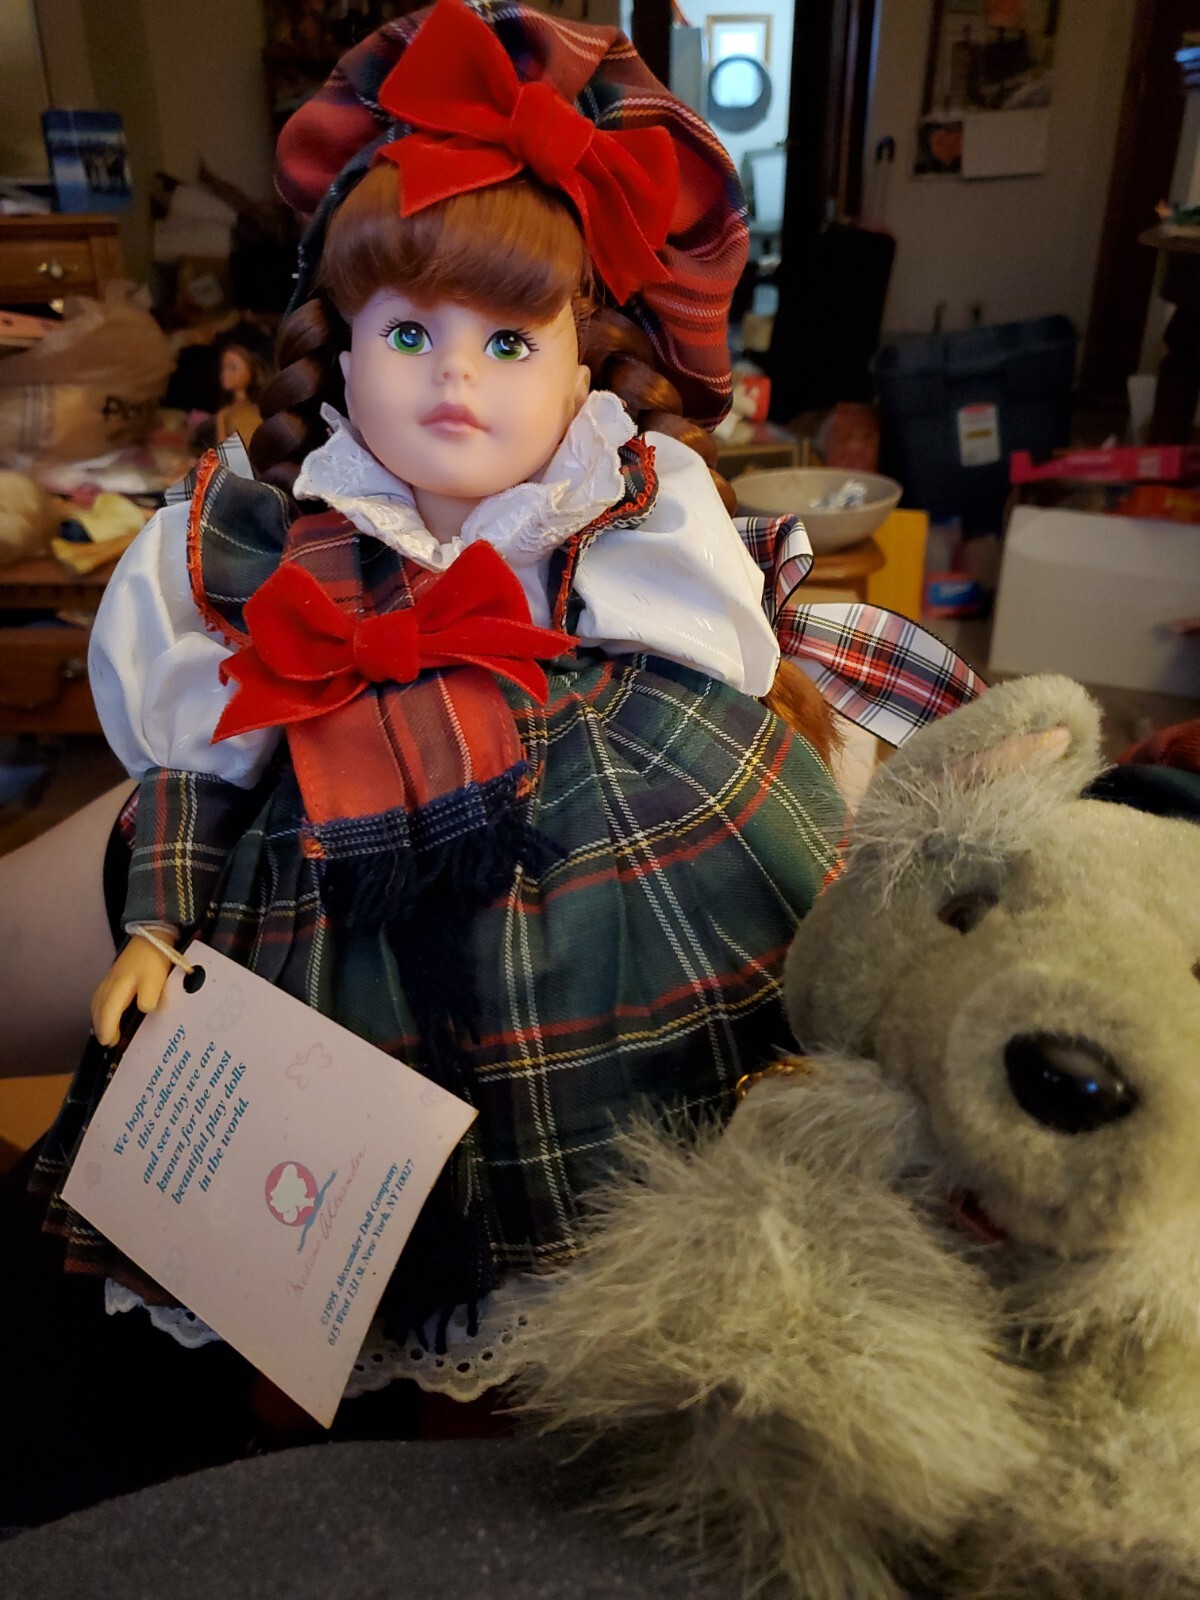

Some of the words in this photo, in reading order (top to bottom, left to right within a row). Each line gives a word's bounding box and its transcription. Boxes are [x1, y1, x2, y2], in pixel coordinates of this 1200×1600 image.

[114, 1133, 129, 1155] We
[146, 1065, 164, 1098] you
[162, 1025, 186, 1064] enjoy
[138, 1120, 155, 1149] this
[154, 1050, 192, 1118] collection
[143, 1150, 159, 1184] and
[157, 1127, 171, 1152] see
[170, 1093, 189, 1126] why
[186, 1069, 200, 1092] we
[200, 1041, 216, 1068] are
[156, 1141, 185, 1193] known
[181, 1114, 196, 1146] for
[194, 1088, 211, 1115] the
[209, 1050, 232, 1088] most
[171, 1132, 209, 1204] beautiful
[206, 1100, 226, 1140] play
[224, 1062, 246, 1099] dolls
[198, 1175, 211, 1192] in
[207, 1147, 224, 1174] the
[221, 1097, 249, 1147] world.
[328, 1324, 340, 1346] 615
[335, 1298, 351, 1325] West
[347, 1278, 359, 1298] 131
[362, 1239, 376, 1264] New
[386, 1190, 399, 1211] NY
[395, 1158, 415, 1191] 10027
[336, 1235, 362, 1290] Alexander
[359, 1211, 374, 1236] Doll
[371, 1162, 398, 1212] Company
